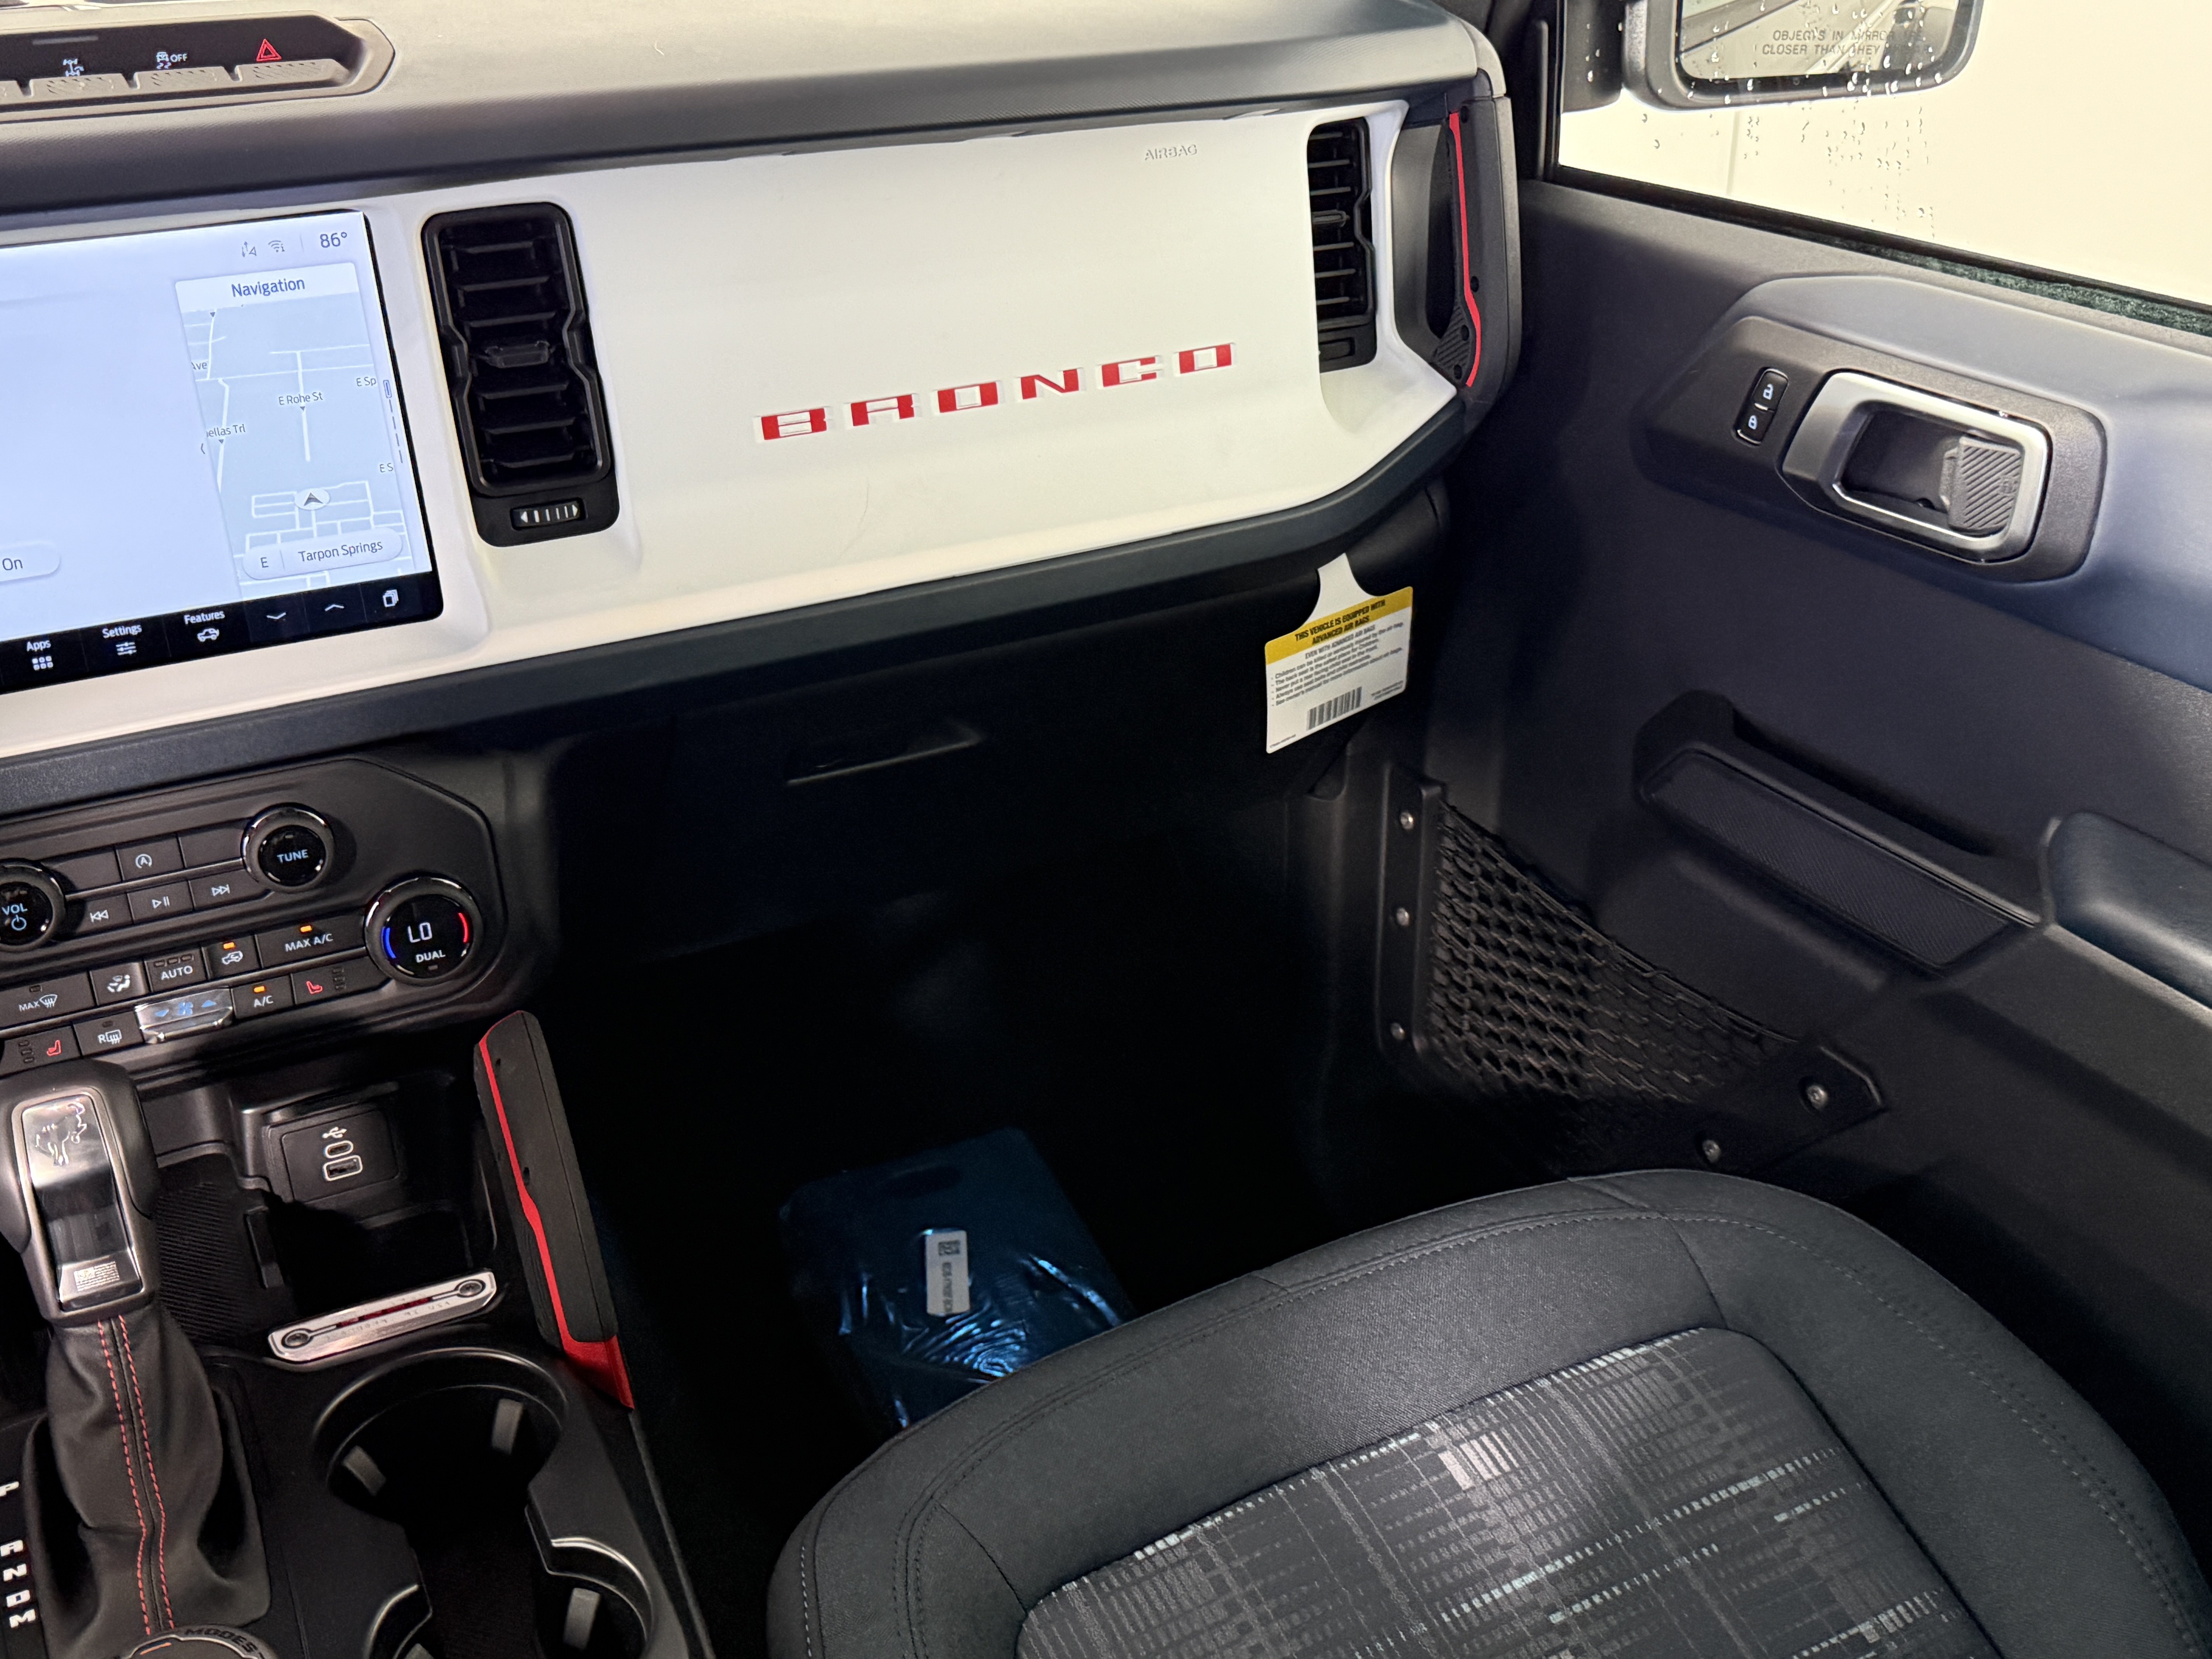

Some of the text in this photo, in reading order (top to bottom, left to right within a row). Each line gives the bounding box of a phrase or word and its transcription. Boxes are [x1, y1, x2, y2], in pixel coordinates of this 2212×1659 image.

[1832, 30, 1843, 40] IN
[1762, 44, 1807, 55] CLOSER
[1851, 44, 1880, 55] HEY
[170, 53, 188, 62] OFF
[1145, 144, 1197, 160] AIRBAG
[319, 231, 347, 249] 86°
[232, 278, 305, 297] Navigation
[278, 396, 285, 405] E
[312, 392, 323, 401] St
[754, 342, 1237, 443] BRONCO
[260, 541, 383, 568] E Tarpon Springs
[2, 557, 24, 571] On
[184, 610, 225, 625] Features
[102, 623, 143, 639] Settings
[26, 639, 52, 652] Apps
[277, 849, 308, 864] TUNE
[2, 903, 28, 915] VOL
[285, 934, 333, 952] MAX A/C
[416, 950, 446, 963] DUAL
[161, 966, 193, 980] AUTO
[19, 1001, 40, 1012] MAX
[253, 996, 273, 1008] A/C
[98, 1035, 107, 1043] R
[0, 1481, 19, 1497] P
[3, 1563, 27, 1582] N
[9, 1609, 36, 1628] M
[185, 1628, 258, 1652] MODES
